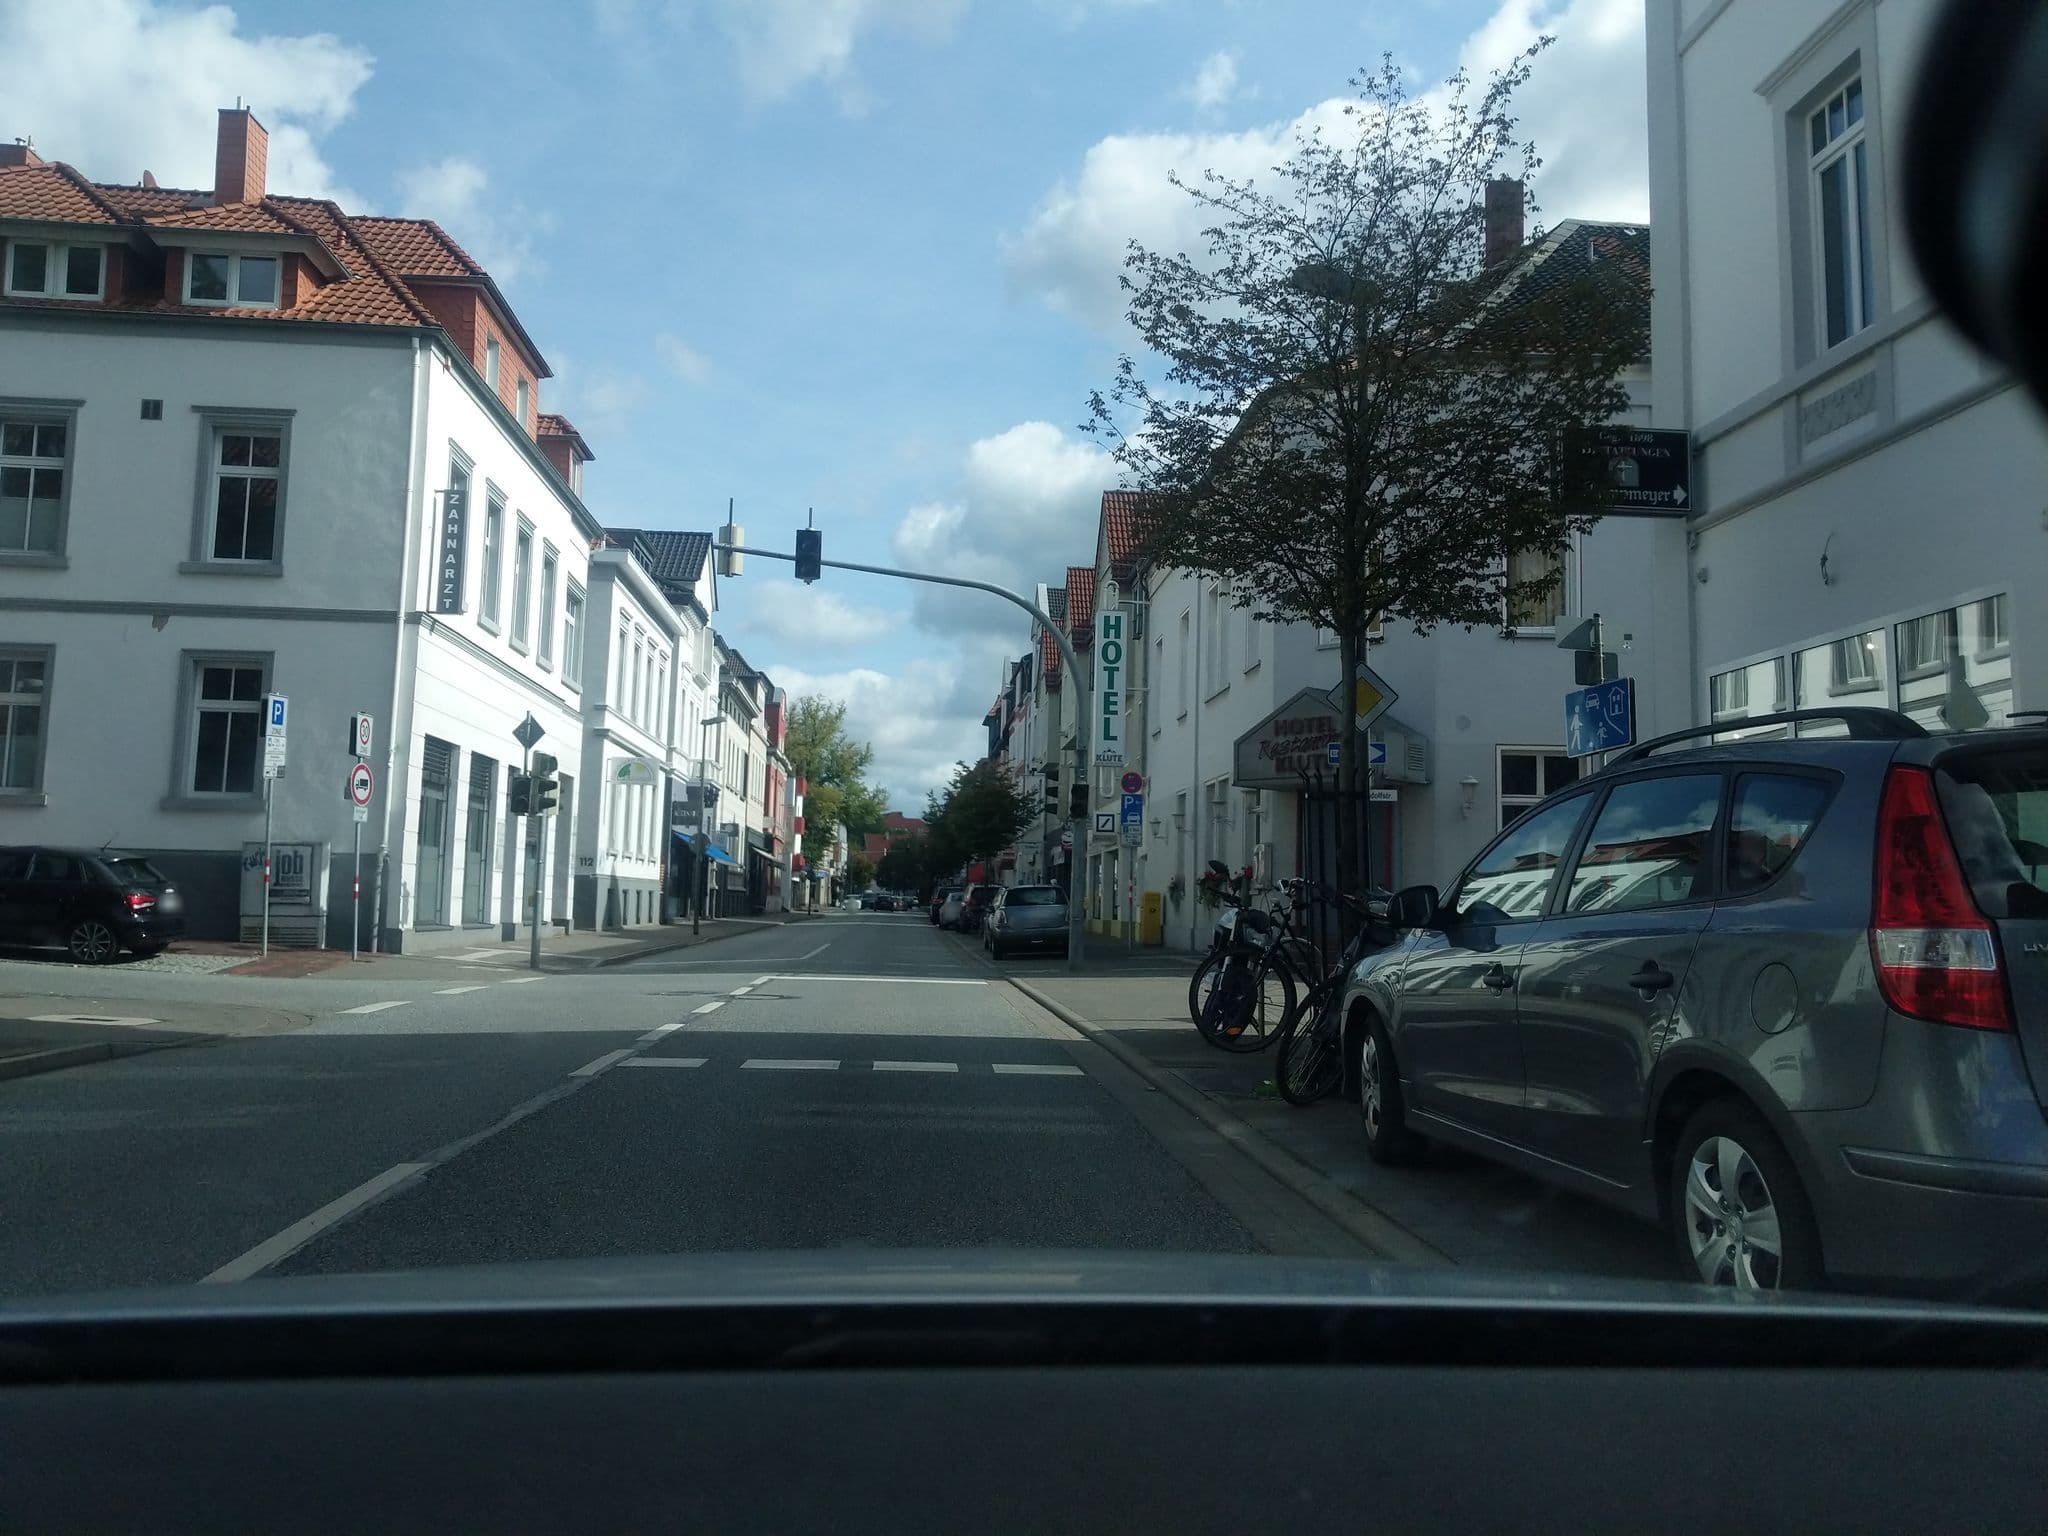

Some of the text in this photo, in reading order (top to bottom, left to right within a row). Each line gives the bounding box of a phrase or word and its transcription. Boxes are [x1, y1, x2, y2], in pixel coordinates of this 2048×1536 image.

[443, 494, 460, 609] ZAHNARZT
[1101, 615, 1123, 741] HOTEL
[274, 703, 282, 723] P
[1274, 716, 1335, 737] HOTEL
[1096, 754, 1123, 763] KLUTE
[1124, 796, 1134, 809] P
[579, 857, 594, 867] 112
